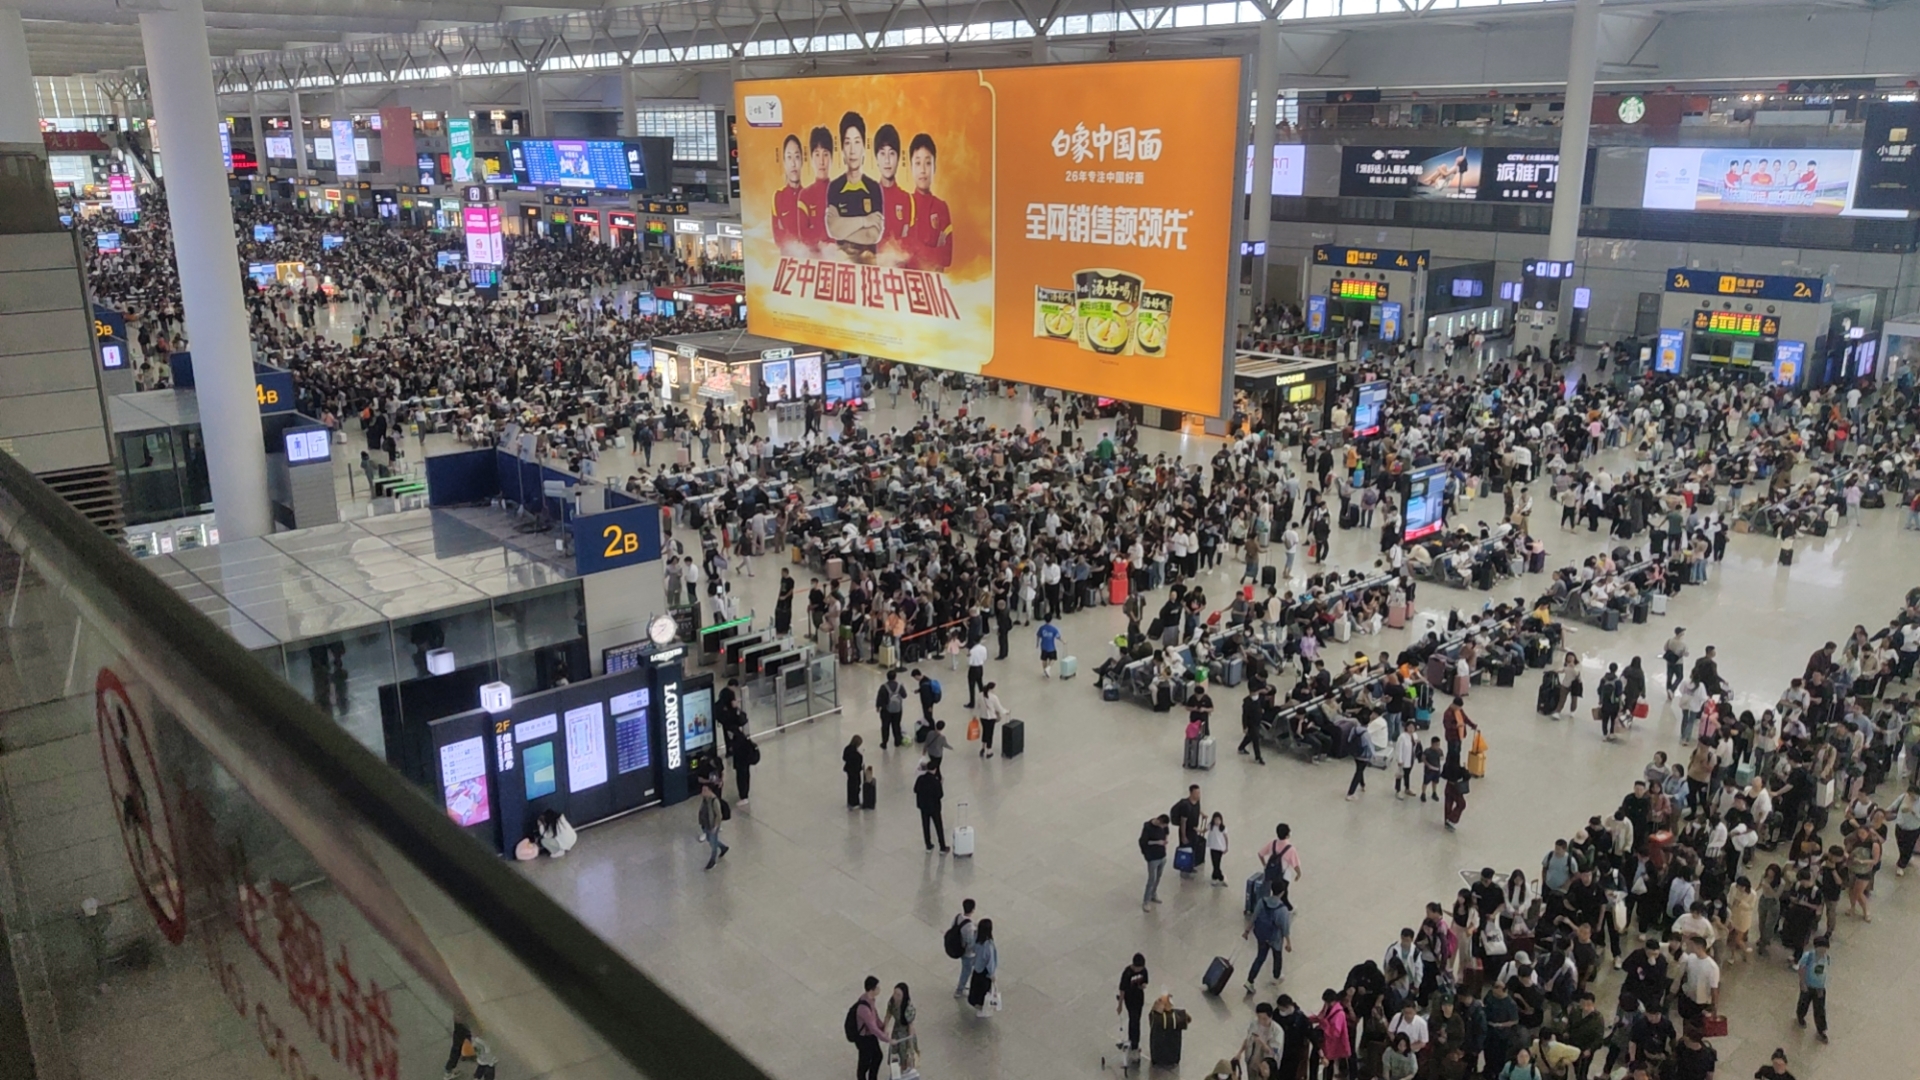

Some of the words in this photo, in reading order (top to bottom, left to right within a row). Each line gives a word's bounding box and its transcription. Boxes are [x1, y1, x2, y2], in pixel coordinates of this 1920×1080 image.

[1051, 121, 1162, 164] 白象中国面
[1877, 145, 1912, 156] 小罐茶
[1065, 170, 1144, 184] 26年专注中国好面
[1317, 249, 1328, 261] 5A
[1396, 255, 1409, 267] 4A
[772, 257, 856, 305] 吃中国面
[861, 265, 960, 320] 挺中国队
[1091, 279, 1131, 302] 汤好喝
[1674, 273, 1690, 288] 3A
[1793, 282, 1812, 298] 2A
[94, 320, 113, 336] 6B
[254, 384, 279, 405] 4B
[602, 524, 639, 558] 2B
[495, 719, 511, 734] 2F
[664, 682, 681, 770] LONGINES
